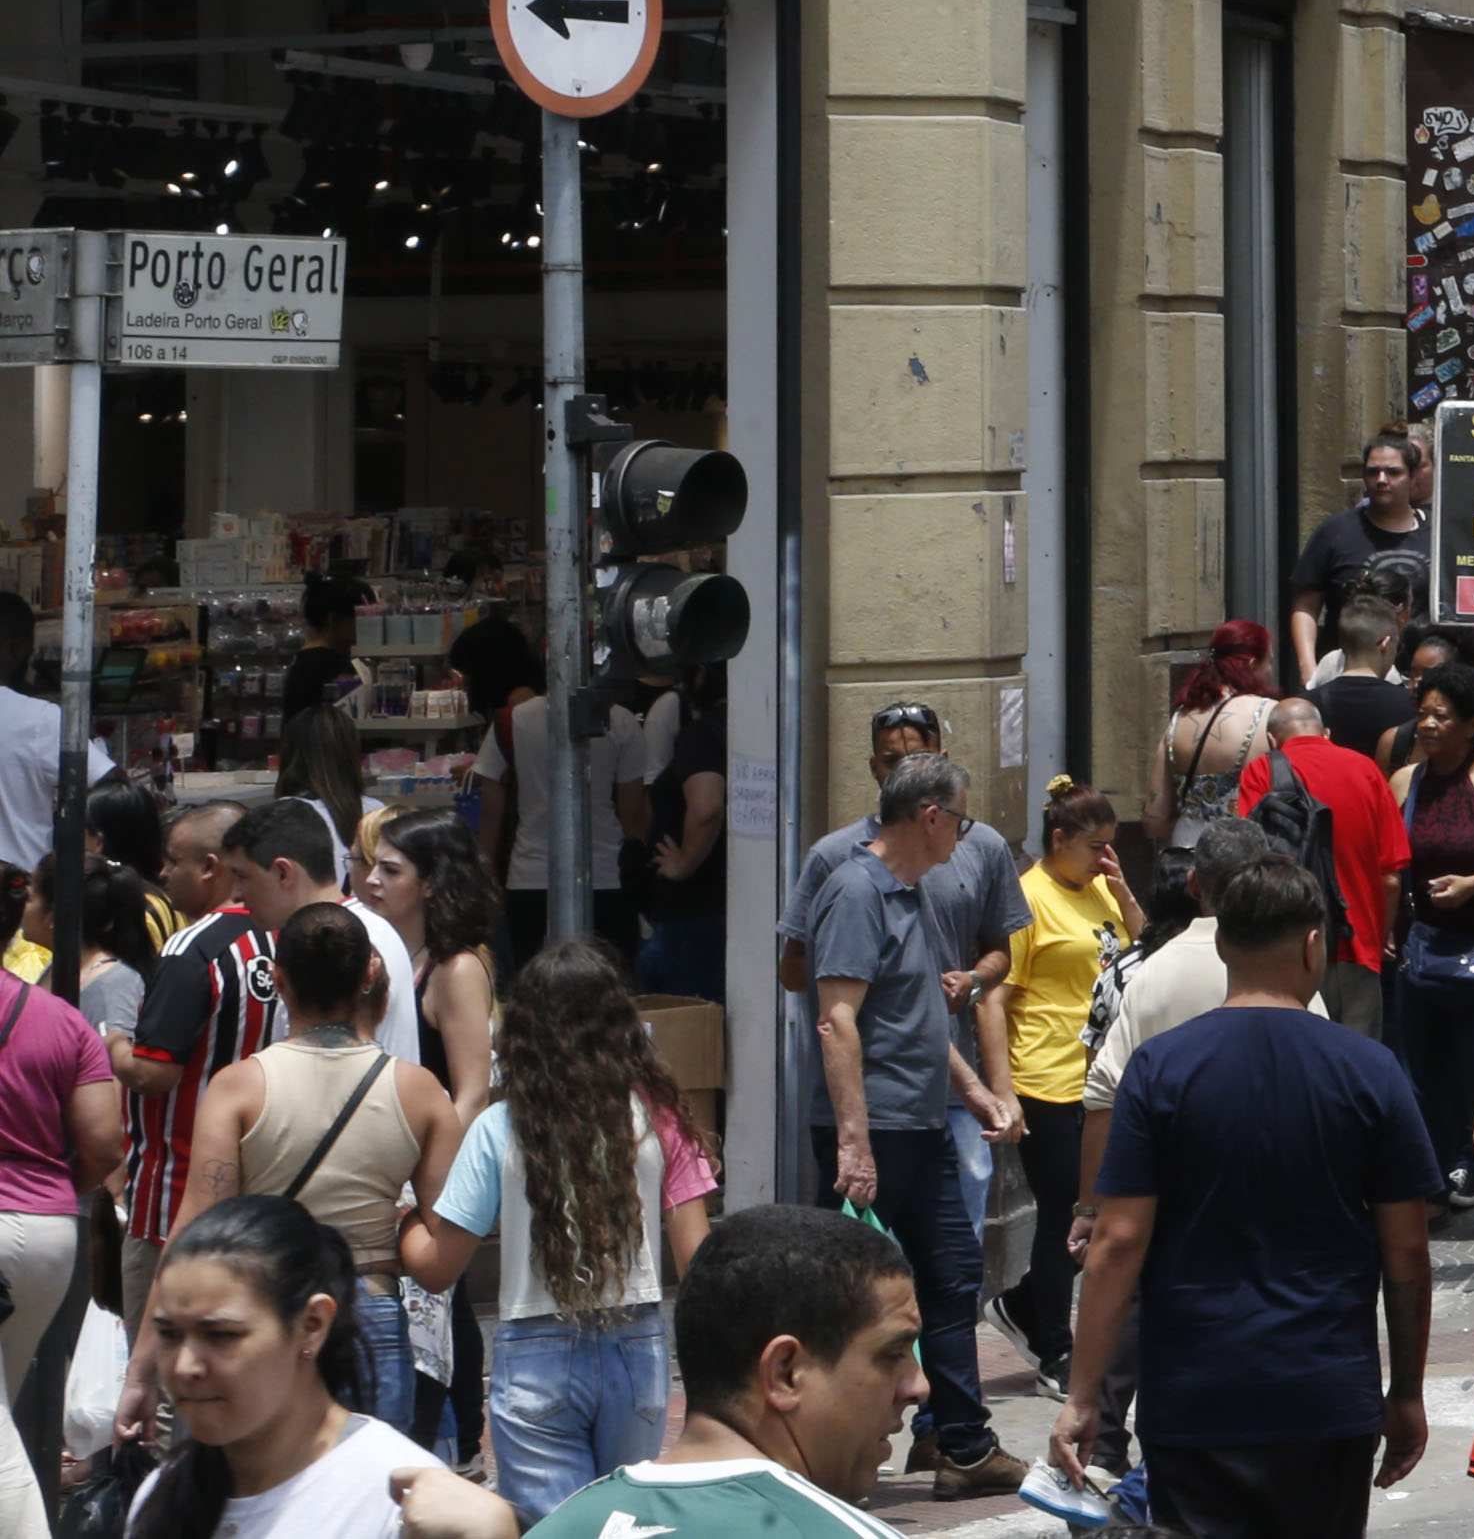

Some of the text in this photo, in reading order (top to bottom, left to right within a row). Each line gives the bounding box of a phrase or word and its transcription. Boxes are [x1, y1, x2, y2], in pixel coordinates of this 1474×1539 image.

[128, 240, 339, 295] Porto Geral
[126, 310, 263, 330] Ladeira Porto Geral
[126, 344, 188, 360] 106 a 14
